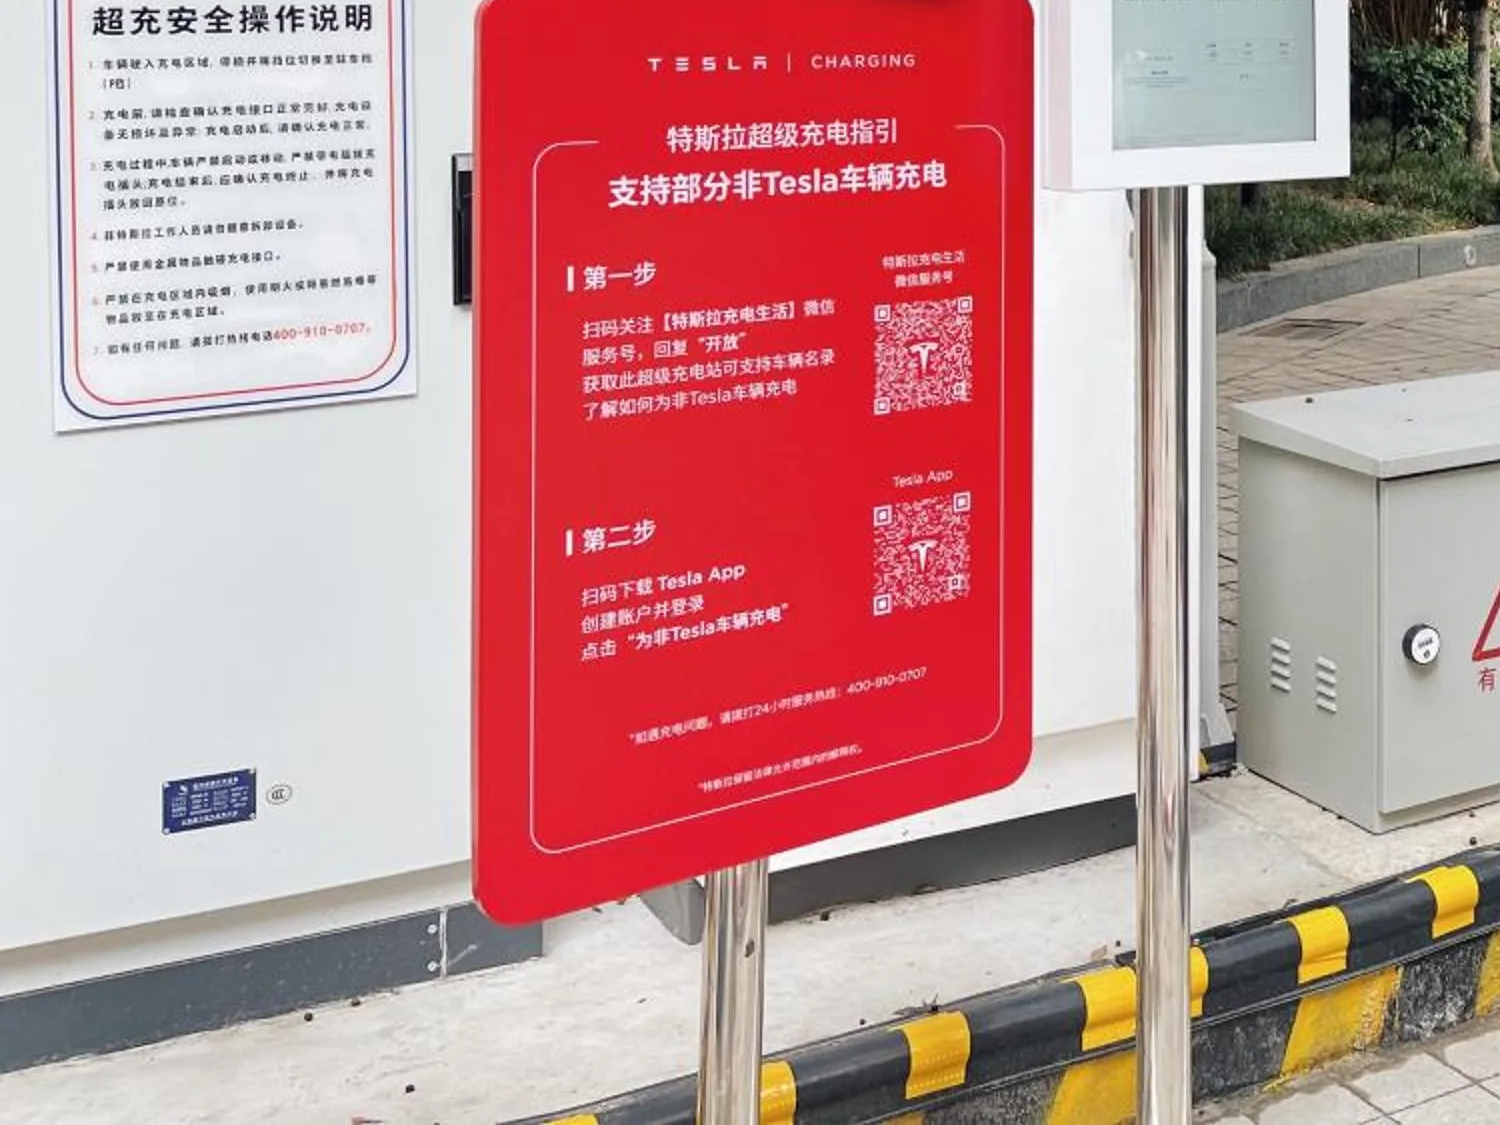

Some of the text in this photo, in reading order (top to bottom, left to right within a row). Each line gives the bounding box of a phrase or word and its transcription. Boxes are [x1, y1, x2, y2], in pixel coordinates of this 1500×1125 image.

[92, 3, 374, 36] 超充安全操作说明
[647, 53, 916, 72] TESLA CHARGING
[666, 117, 898, 154] 特斯拉超级充电指引
[607, 159, 948, 210] 支持部分非Tesla车辆充电
[583, 260, 657, 291] 第一步
[582, 349, 836, 395] 获取此超级充电站可支持车辆名录
[582, 378, 798, 422] 了解如何为非Tesla车辆充电
[893, 469, 954, 488] Tesla App
[582, 518, 657, 554] 第二步
[581, 564, 746, 608] 扫码下载 Tesla App
[581, 594, 705, 635] 创建账户并登录
